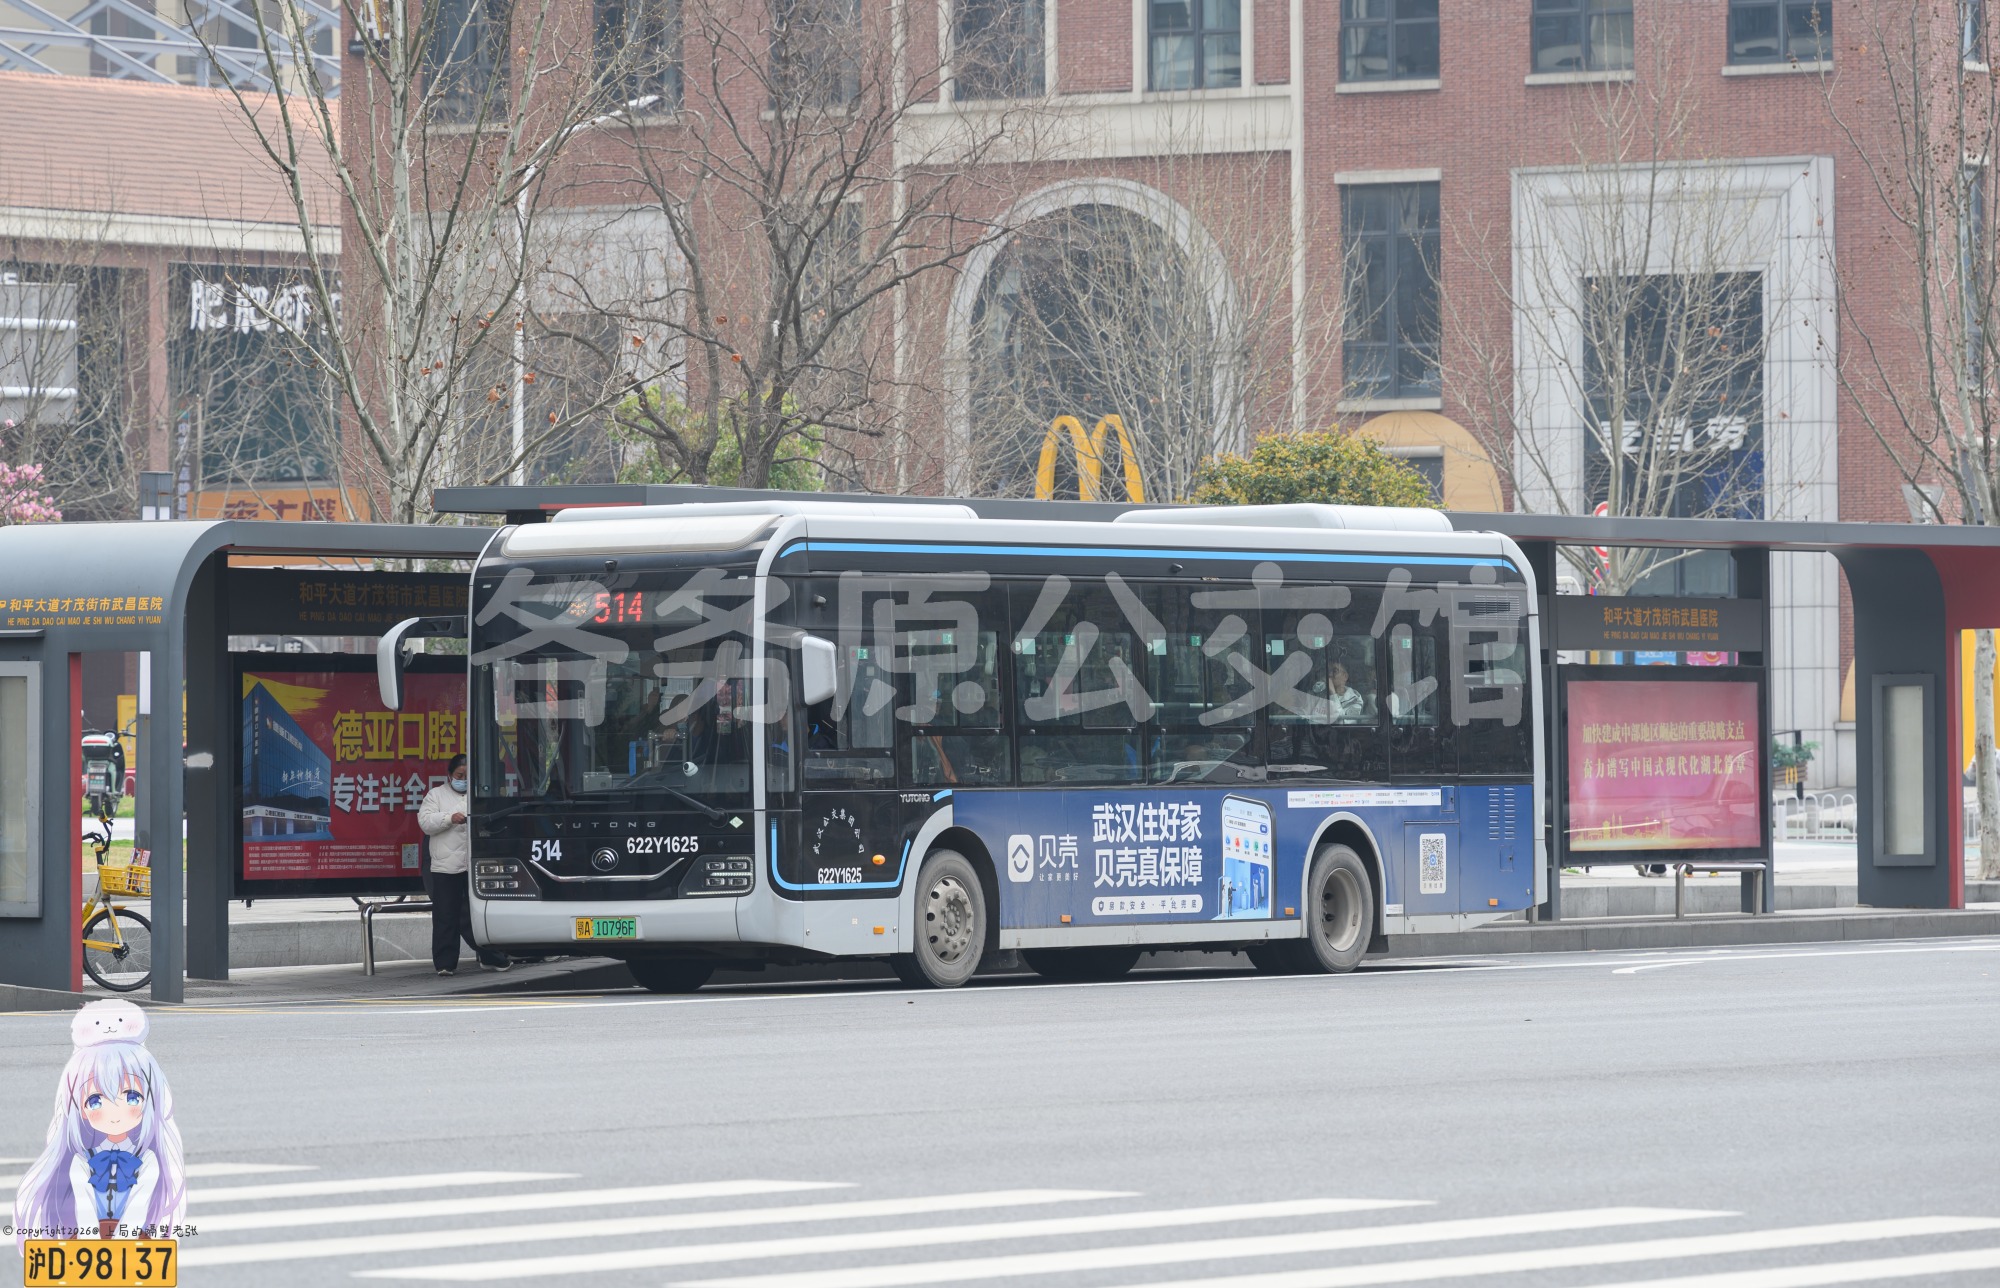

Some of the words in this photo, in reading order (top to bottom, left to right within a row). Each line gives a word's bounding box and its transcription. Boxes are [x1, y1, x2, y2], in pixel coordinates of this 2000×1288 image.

[9, 596, 163, 612] 和平大道才茂街市武昌医院
[299, 581, 468, 608] 和平大道才茂街市武昌医院
[595, 592, 643, 623] 514
[1603, 606, 1718, 627] 和平大道才茂街市武昌医院
[7, 617, 14, 625] HE
[17, 617, 29, 625] PING
[32, 617, 40, 625] DA
[42, 617, 53, 625] DAO
[56, 617, 65, 625] CAI
[68, 617, 80, 625] MAO
[93, 616, 102, 624] SHI
[105, 616, 113, 624] WU
[117, 616, 135, 624] CHANG
[138, 616, 143, 624] YI
[146, 616, 161, 624] YUAN
[332, 709, 517, 762] 德亚口腔
[1582, 720, 1745, 744] 加快建成中部地区崛起的重要战略支点
[1583, 754, 1746, 779] 奋力谱写中国式现代化湖北篇章
[900, 793, 930, 803] YUTONG
[555, 821, 656, 829] YUTONG
[1092, 801, 1202, 843] 武汉住好家
[531, 839, 562, 862] 514
[626, 835, 699, 854] 622Y1625
[1039, 834, 1078, 868] 贝壳
[818, 867, 862, 884] 622Y1625
[1093, 845, 1203, 888] 贝壳真保障
